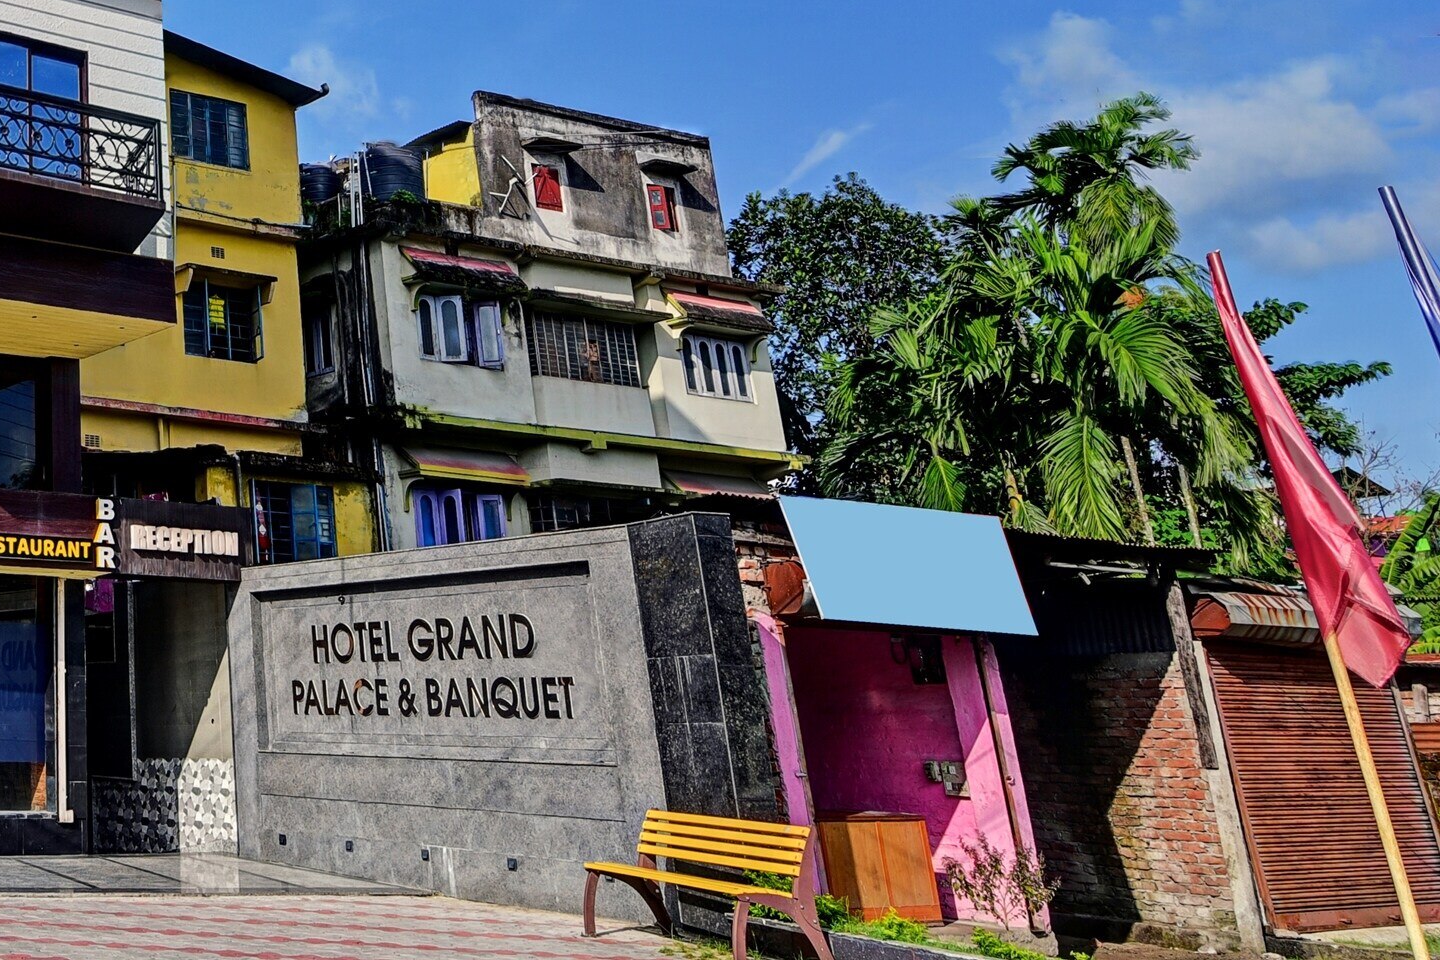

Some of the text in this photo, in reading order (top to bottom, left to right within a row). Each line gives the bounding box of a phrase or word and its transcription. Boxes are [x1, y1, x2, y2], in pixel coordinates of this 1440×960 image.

[94, 497, 116, 569] BAR
[130, 524, 239, 557] RECEPTION
[311, 612, 537, 664] HOTEL GRAND
[292, 676, 575, 720] PALACE & BANQUET
